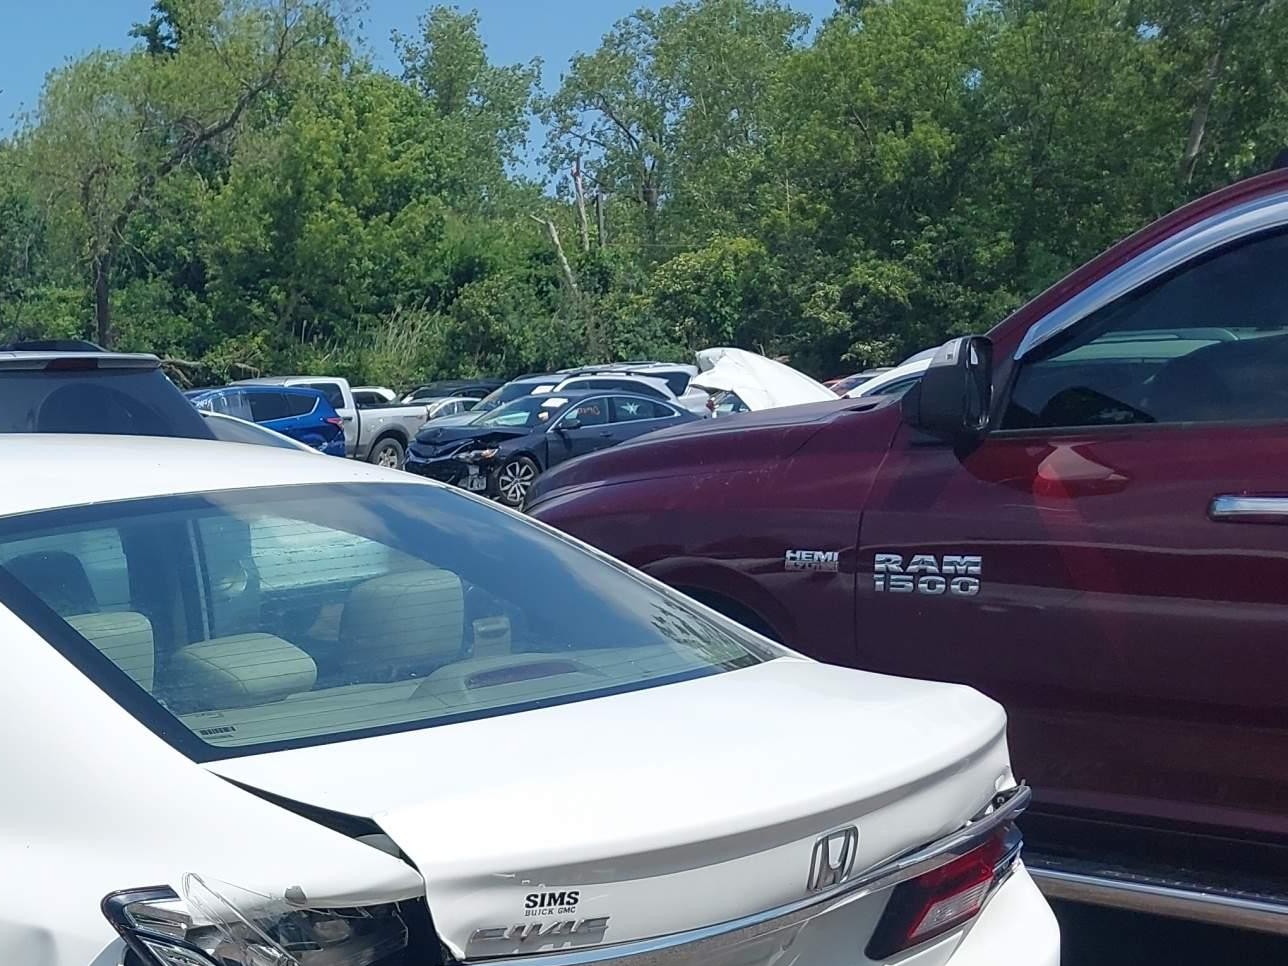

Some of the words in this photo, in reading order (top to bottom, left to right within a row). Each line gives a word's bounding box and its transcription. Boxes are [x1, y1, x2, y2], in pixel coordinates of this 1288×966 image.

[786, 550, 839, 561] HEMI
[874, 553, 982, 574] RAM
[873, 574, 979, 595] 1500
[524, 891, 580, 909] SIMS
[524, 907, 554, 917] BUICK
[557, 906, 576, 914] GMC
